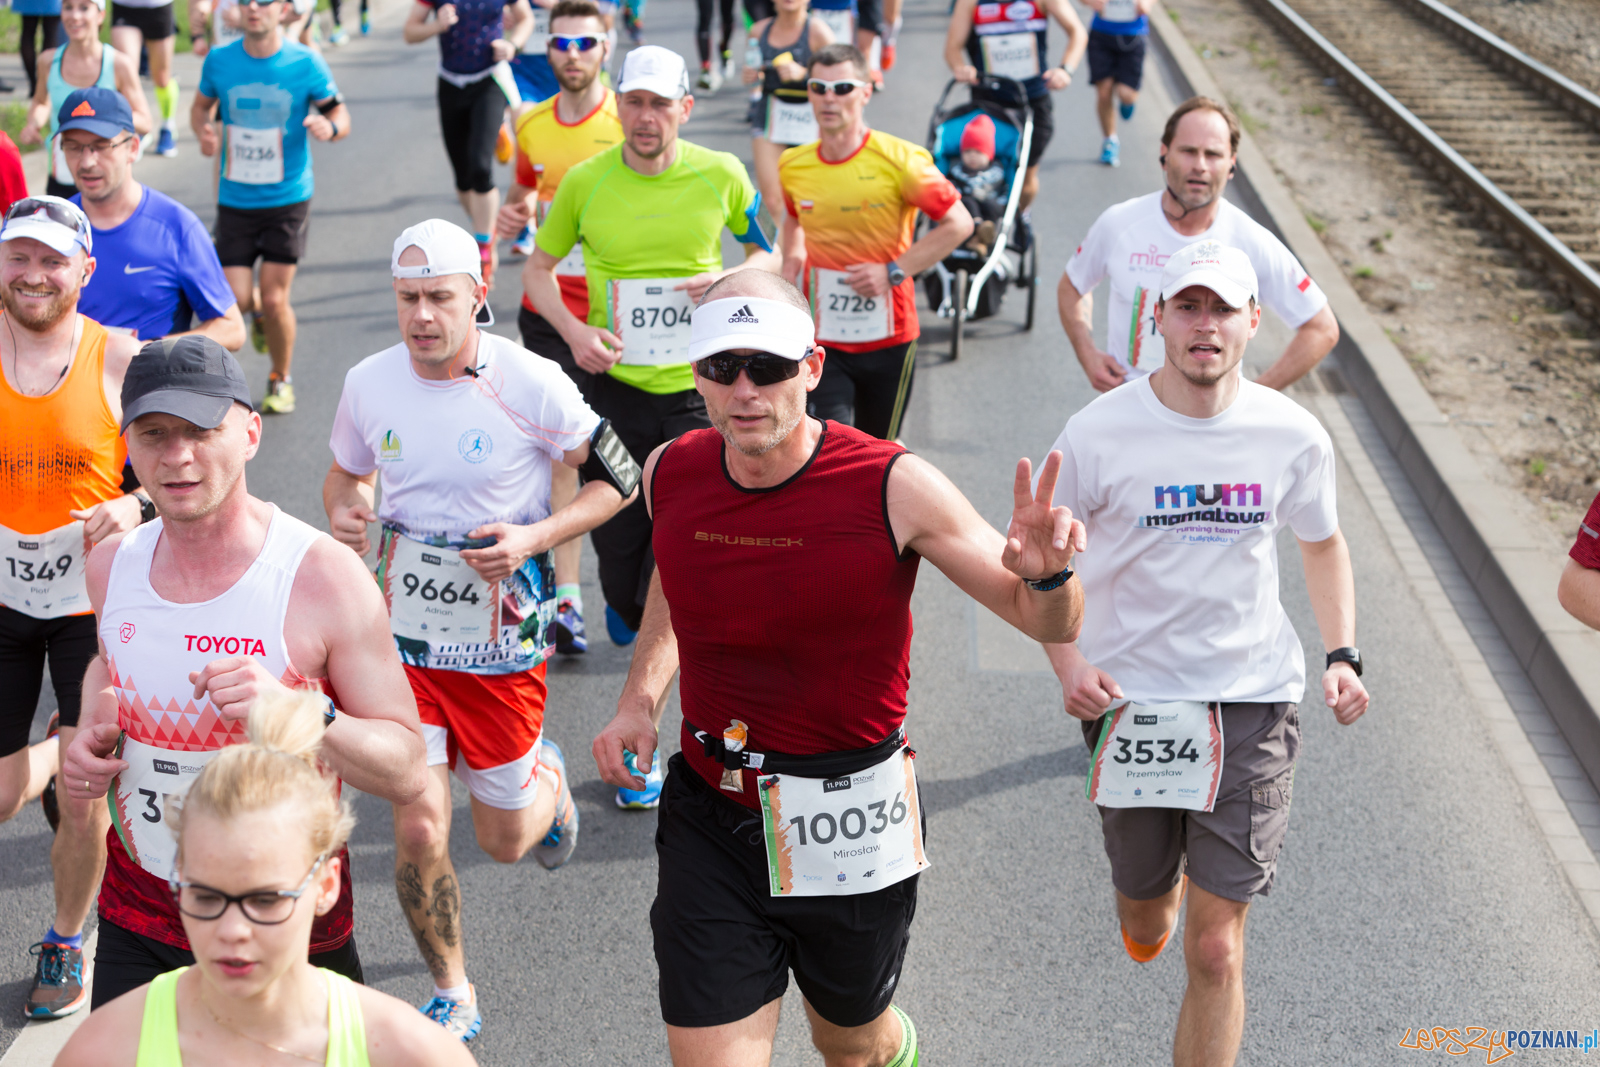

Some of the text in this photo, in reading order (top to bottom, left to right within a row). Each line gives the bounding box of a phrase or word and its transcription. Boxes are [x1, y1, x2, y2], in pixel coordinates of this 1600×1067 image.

[829, 293, 876, 313] 2726
[631, 305, 692, 328] 8704
[728, 315, 759, 323] adidas
[1176, 525, 1212, 534] running
[694, 531, 804, 547] BRUBECK
[6, 554, 72, 582] 1349
[31, 586, 50, 594] Piotr
[403, 573, 479, 605] 9664
[425, 606, 453, 616] Adrian
[184, 635, 266, 657] TOYOTA
[1113, 736, 1199, 764] 3534
[1127, 769, 1183, 778] Przemysław
[790, 791, 907, 845] 10036
[833, 844, 881, 859] Mirosław
